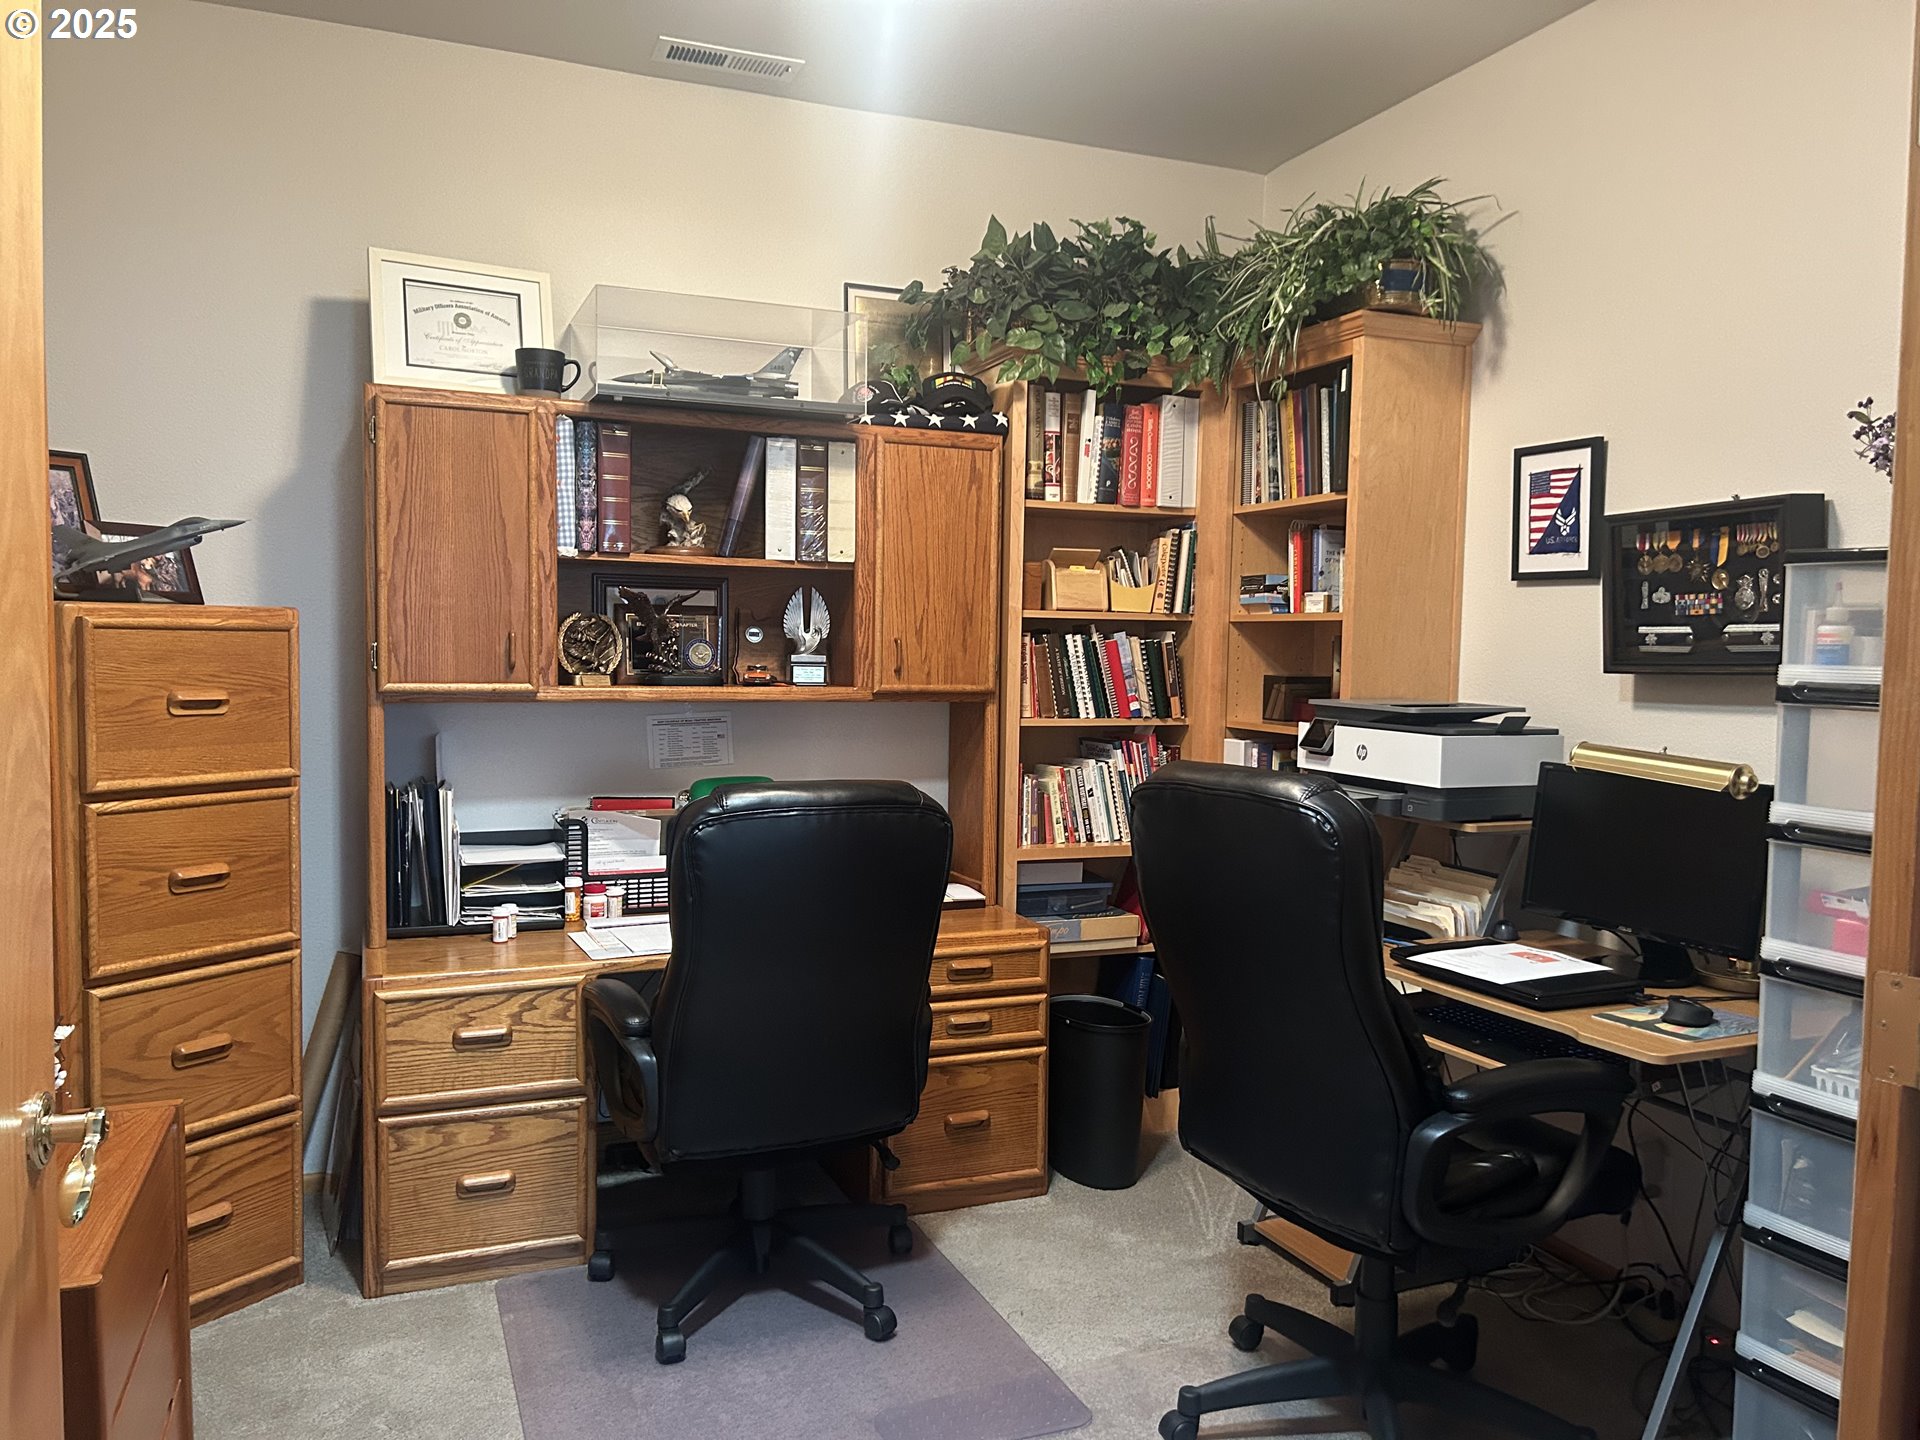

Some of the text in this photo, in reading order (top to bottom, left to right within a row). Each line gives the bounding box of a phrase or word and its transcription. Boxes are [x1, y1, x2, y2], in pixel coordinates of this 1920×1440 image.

[412, 305, 434, 315] Military
[455, 303, 484, 315] Association
[491, 313, 511, 326] America
[1356, 744, 1368, 761] hp
